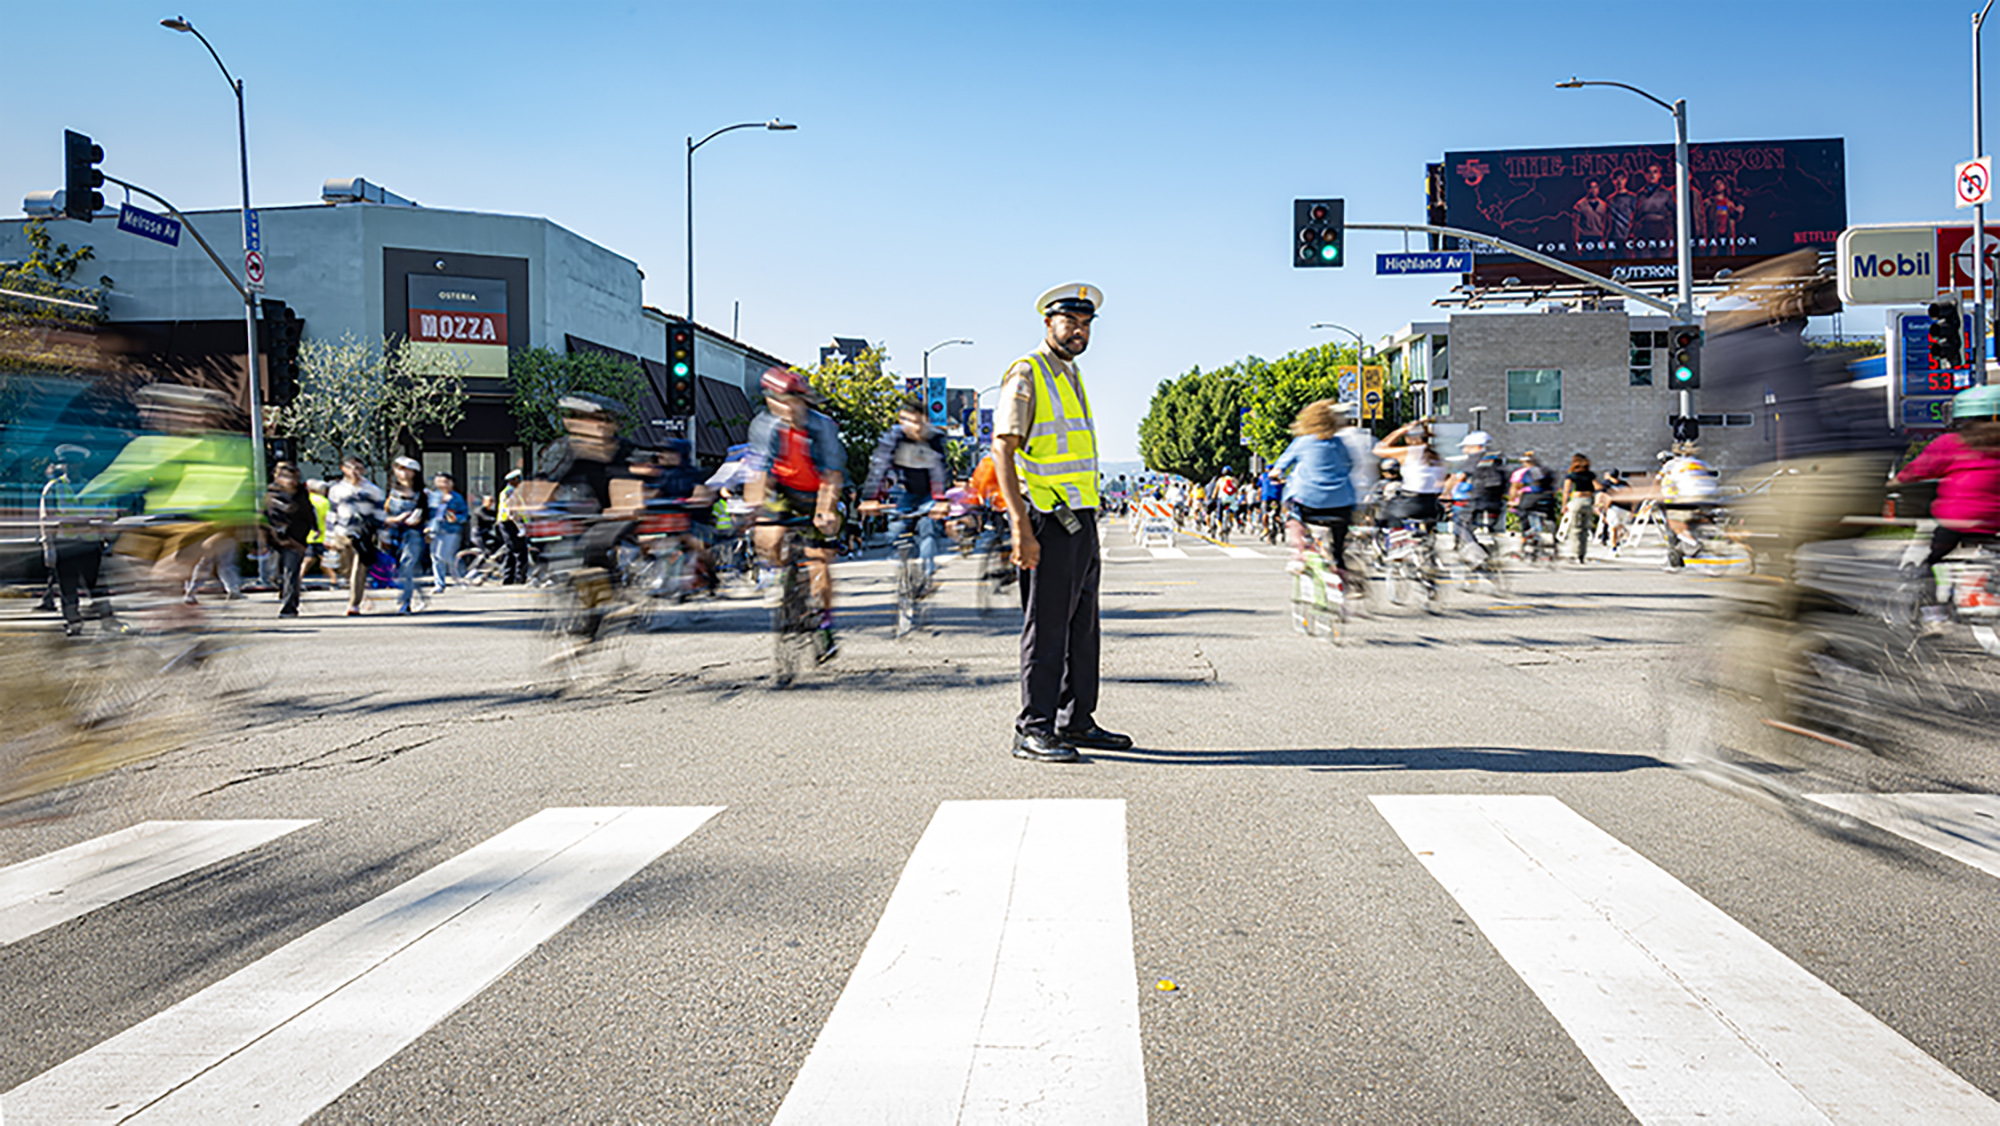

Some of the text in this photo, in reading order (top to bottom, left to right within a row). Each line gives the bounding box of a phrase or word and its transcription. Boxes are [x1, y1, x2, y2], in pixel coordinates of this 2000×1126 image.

[1505, 155, 1563, 178] THE
[124, 209, 177, 239] Melrose Av
[1537, 237, 1758, 251] FOR YOUR CONSIERATION
[1794, 231, 1838, 244] NETFLIX
[1385, 256, 1463, 273] Highland Av
[1854, 252, 1930, 278] Mobil
[438, 291, 477, 301] OSTERIA
[421, 314, 496, 340] MOZZA
